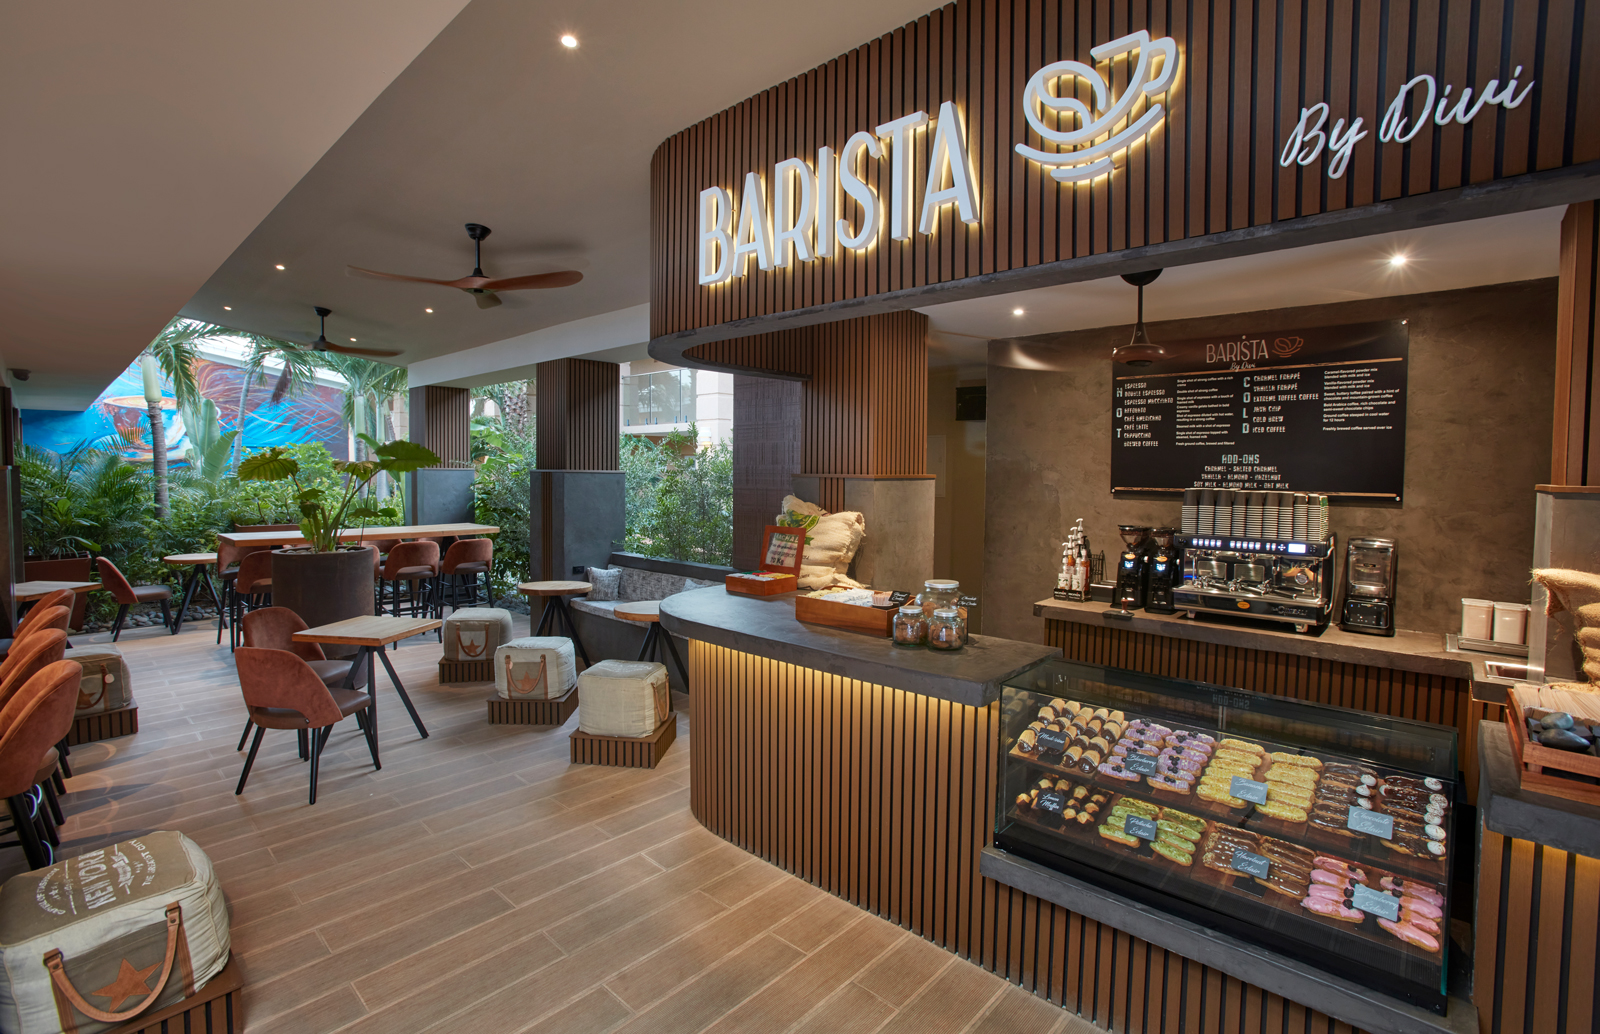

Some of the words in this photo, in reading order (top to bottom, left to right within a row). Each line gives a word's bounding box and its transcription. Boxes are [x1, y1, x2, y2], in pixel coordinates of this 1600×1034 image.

[1280, 102, 1368, 179] By
[1379, 65, 1535, 143] Divi
[699, 100, 980, 285] BARISTA
[1206, 336, 1268, 363] BARISTA
[1230, 362, 1240, 372] By
[1222, 454, 1260, 464] ADD-ONS
[1353, 811, 1389, 824] Chocolate
[128, 840, 145, 850] CITY
[82, 880, 116, 909] NEW
